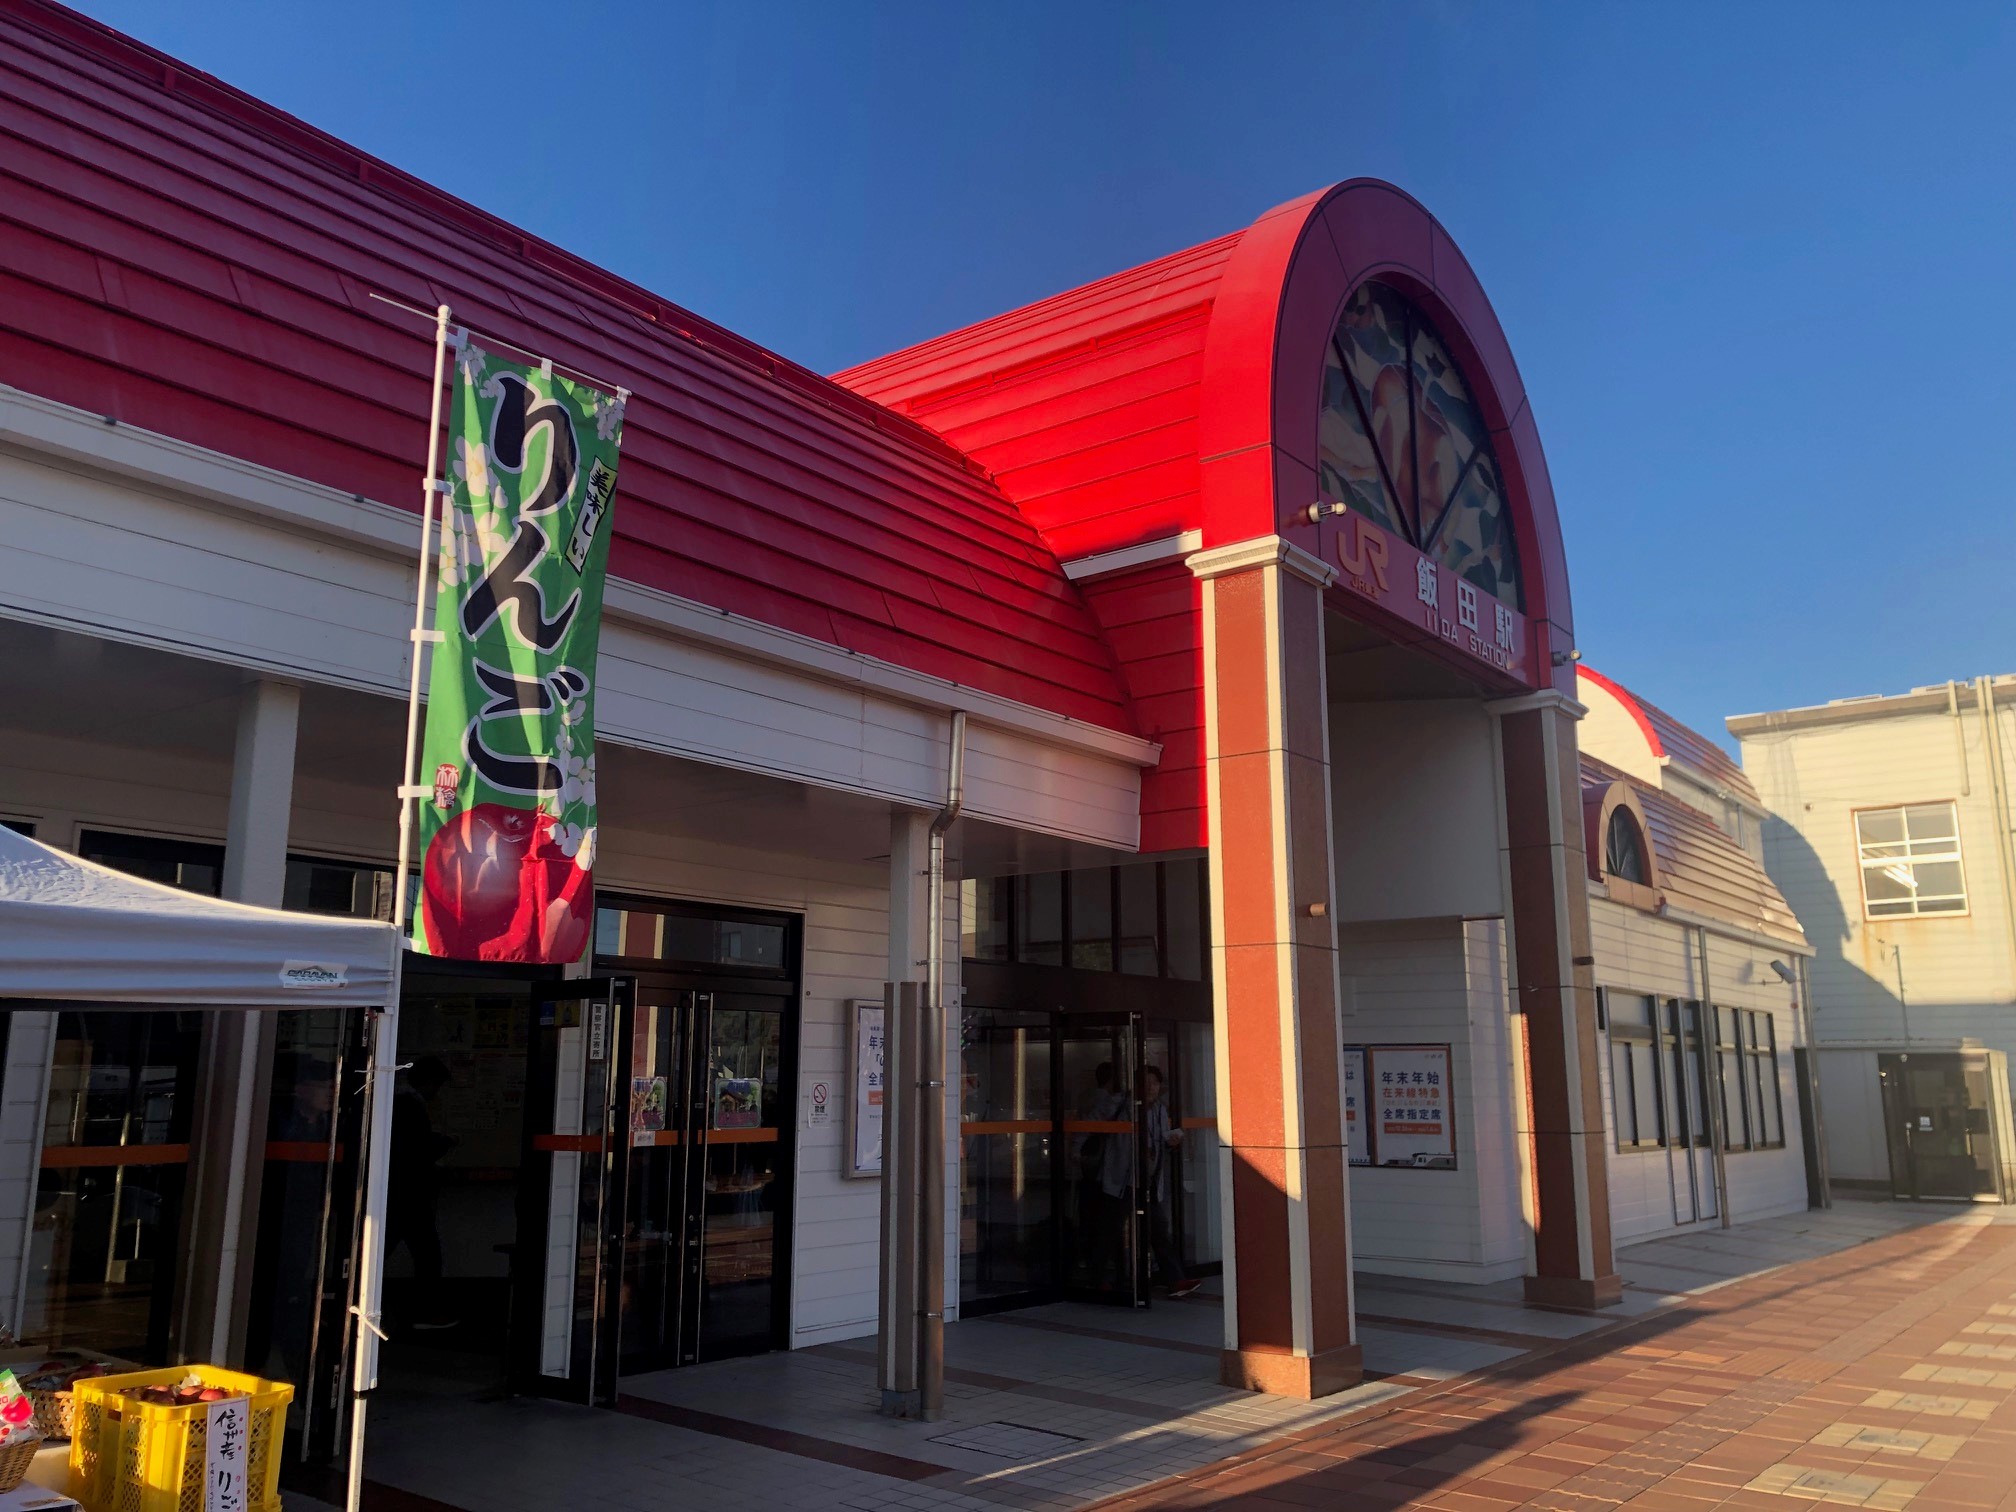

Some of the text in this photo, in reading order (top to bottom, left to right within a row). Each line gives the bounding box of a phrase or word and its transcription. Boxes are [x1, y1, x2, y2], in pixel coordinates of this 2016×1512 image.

[572, 468, 611, 559] 美味しい
[460, 371, 589, 796] りんご
[1336, 517, 1389, 592] JR
[1416, 556, 1515, 654] 飯田駅
[1425, 609, 1509, 670] IIDA STATION
[592, 1005, 603, 1058] 警察官立寄所
[1382, 1071, 1439, 1086] 年末年始
[1383, 1108, 1442, 1121] 全席指定席
